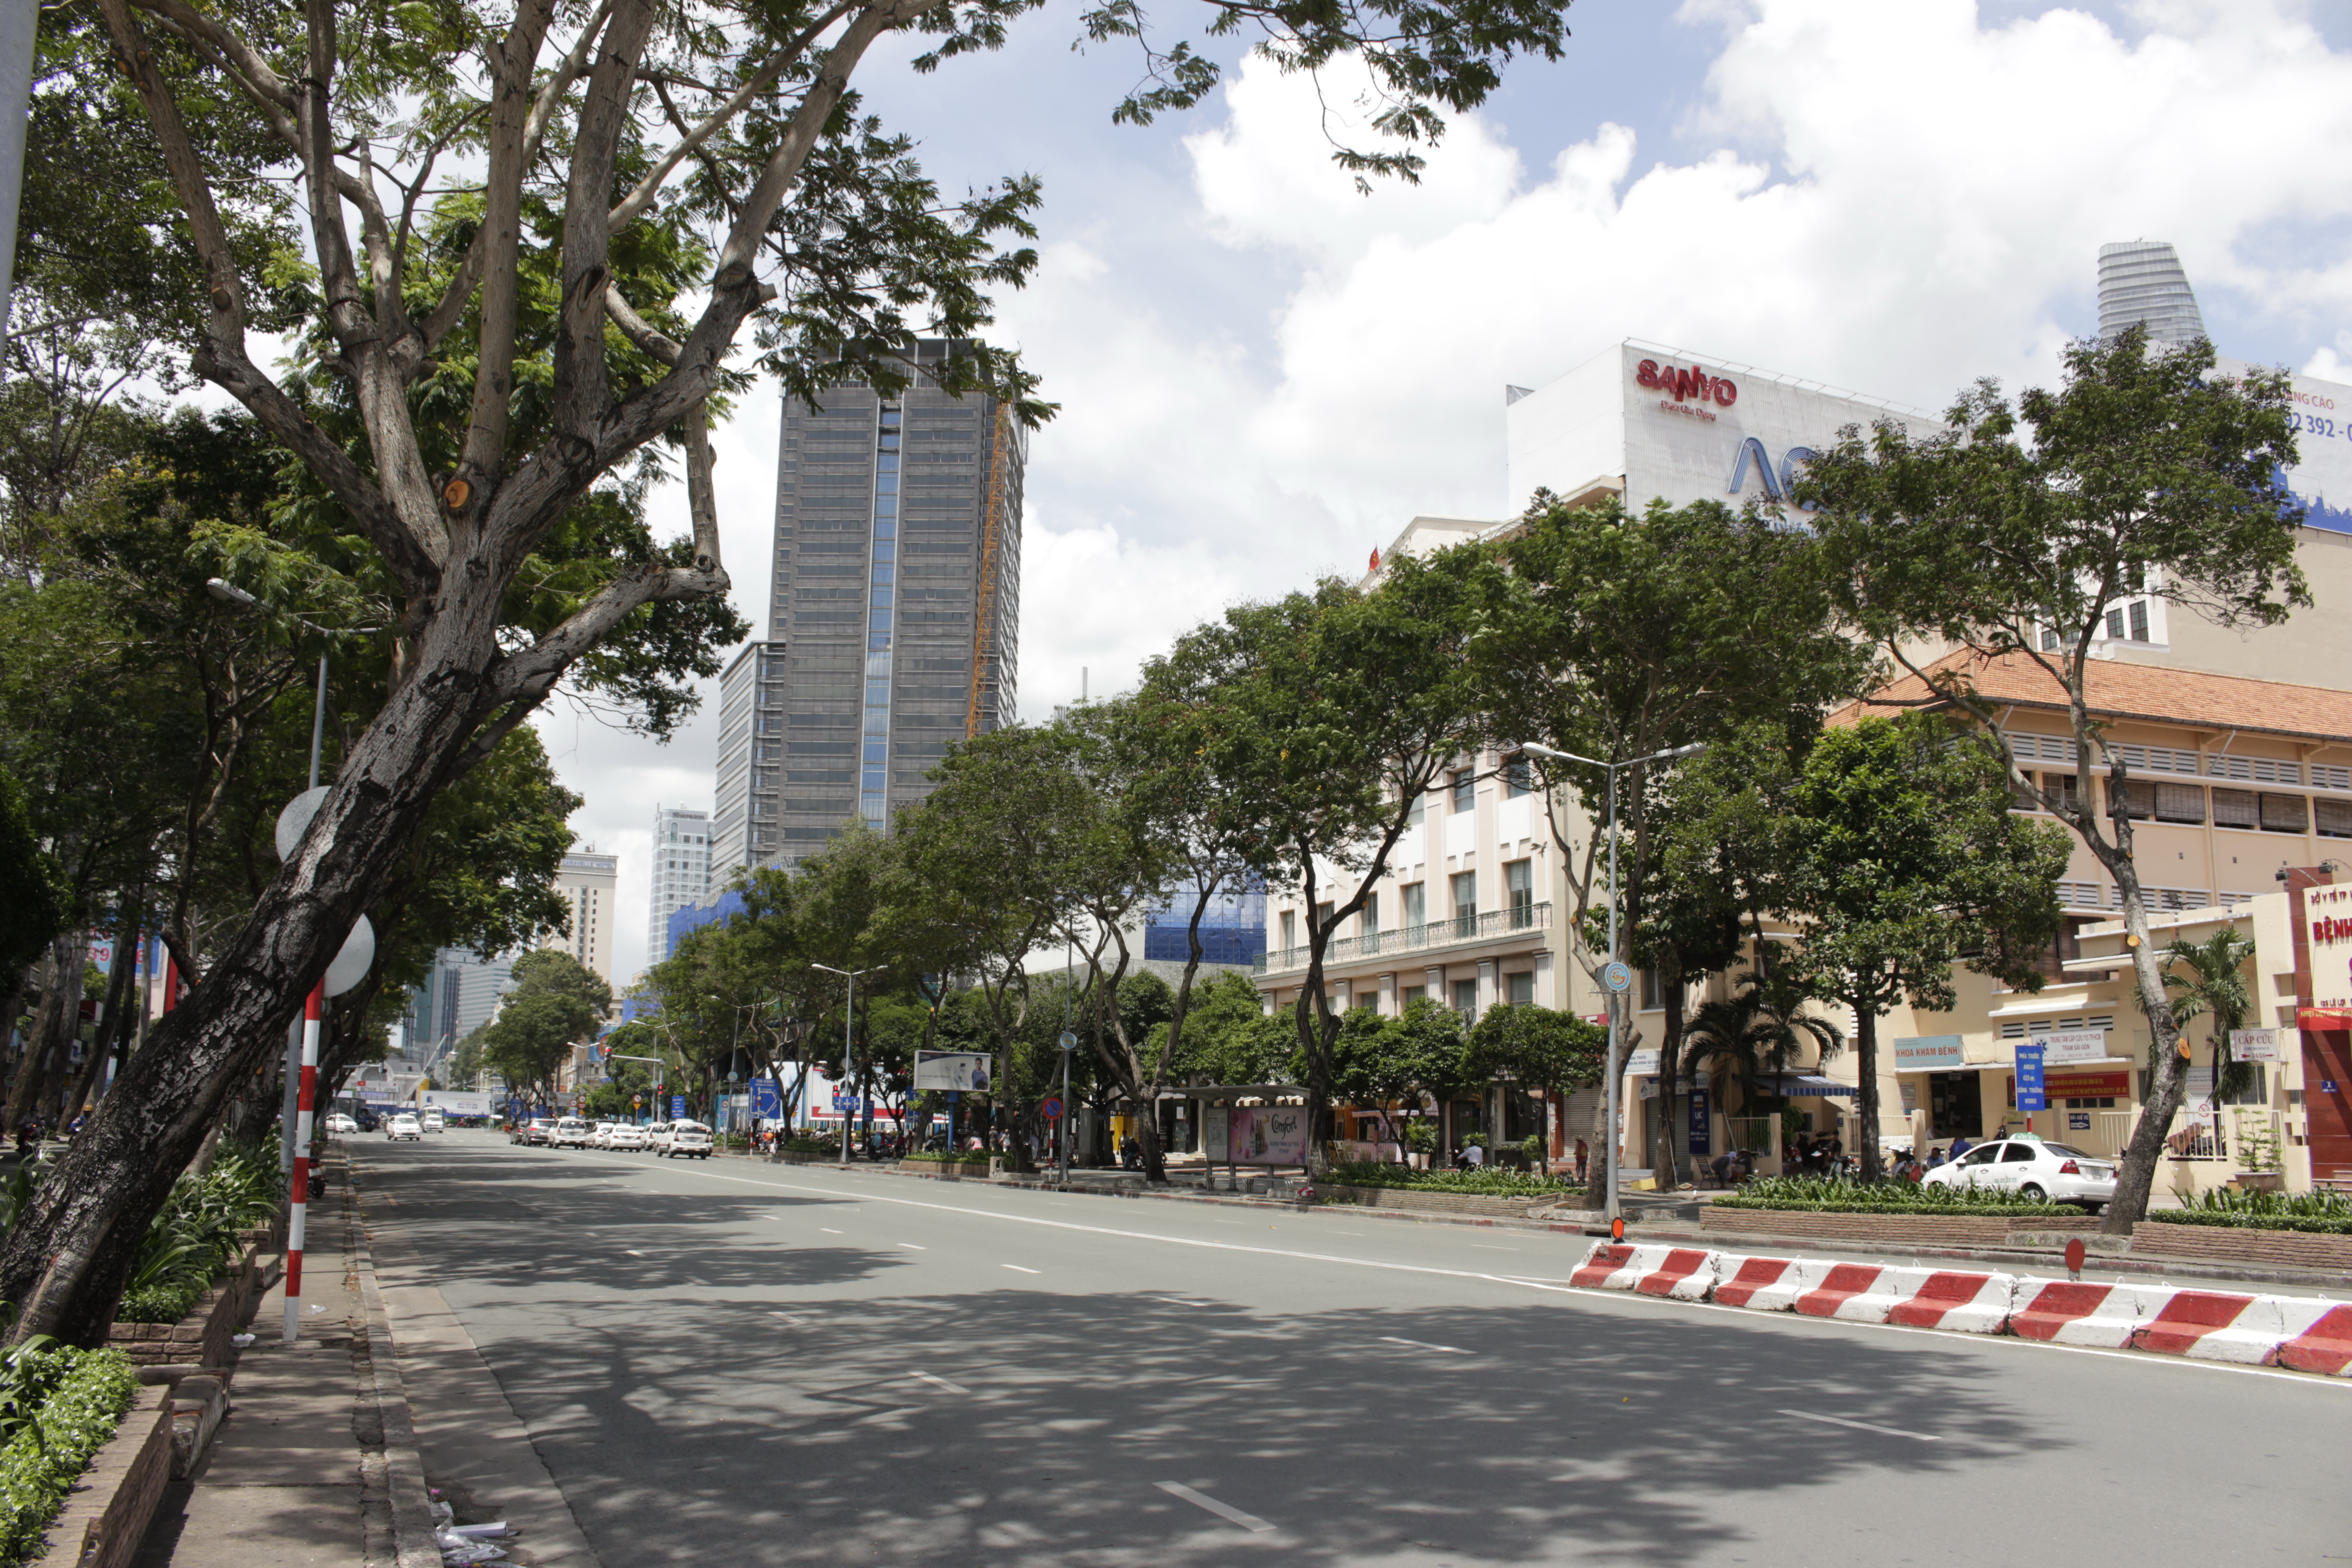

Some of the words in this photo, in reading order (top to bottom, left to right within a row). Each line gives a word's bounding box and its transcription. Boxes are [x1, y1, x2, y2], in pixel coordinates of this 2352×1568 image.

[1637, 359, 1737, 407] SANYO
[2312, 396, 2334, 410] CÁO
[2284, 412, 2303, 431] 92
[2306, 415, 2335, 438] 392
[2311, 891, 2320, 904] SỞ
[2322, 894, 2326, 903] Y
[2329, 888, 2337, 902] TẾ
[2330, 998, 2336, 1006] LÊ
[2239, 1032, 2254, 1044] CẤP
[2257, 1034, 2273, 1044] CỨU
[1896, 1049, 1914, 1058] KHOA
[1916, 1046, 1936, 1057] KHÁM
[1938, 1044, 1958, 1057] BỆNH
[1271, 1113, 1298, 1140] Comfort
